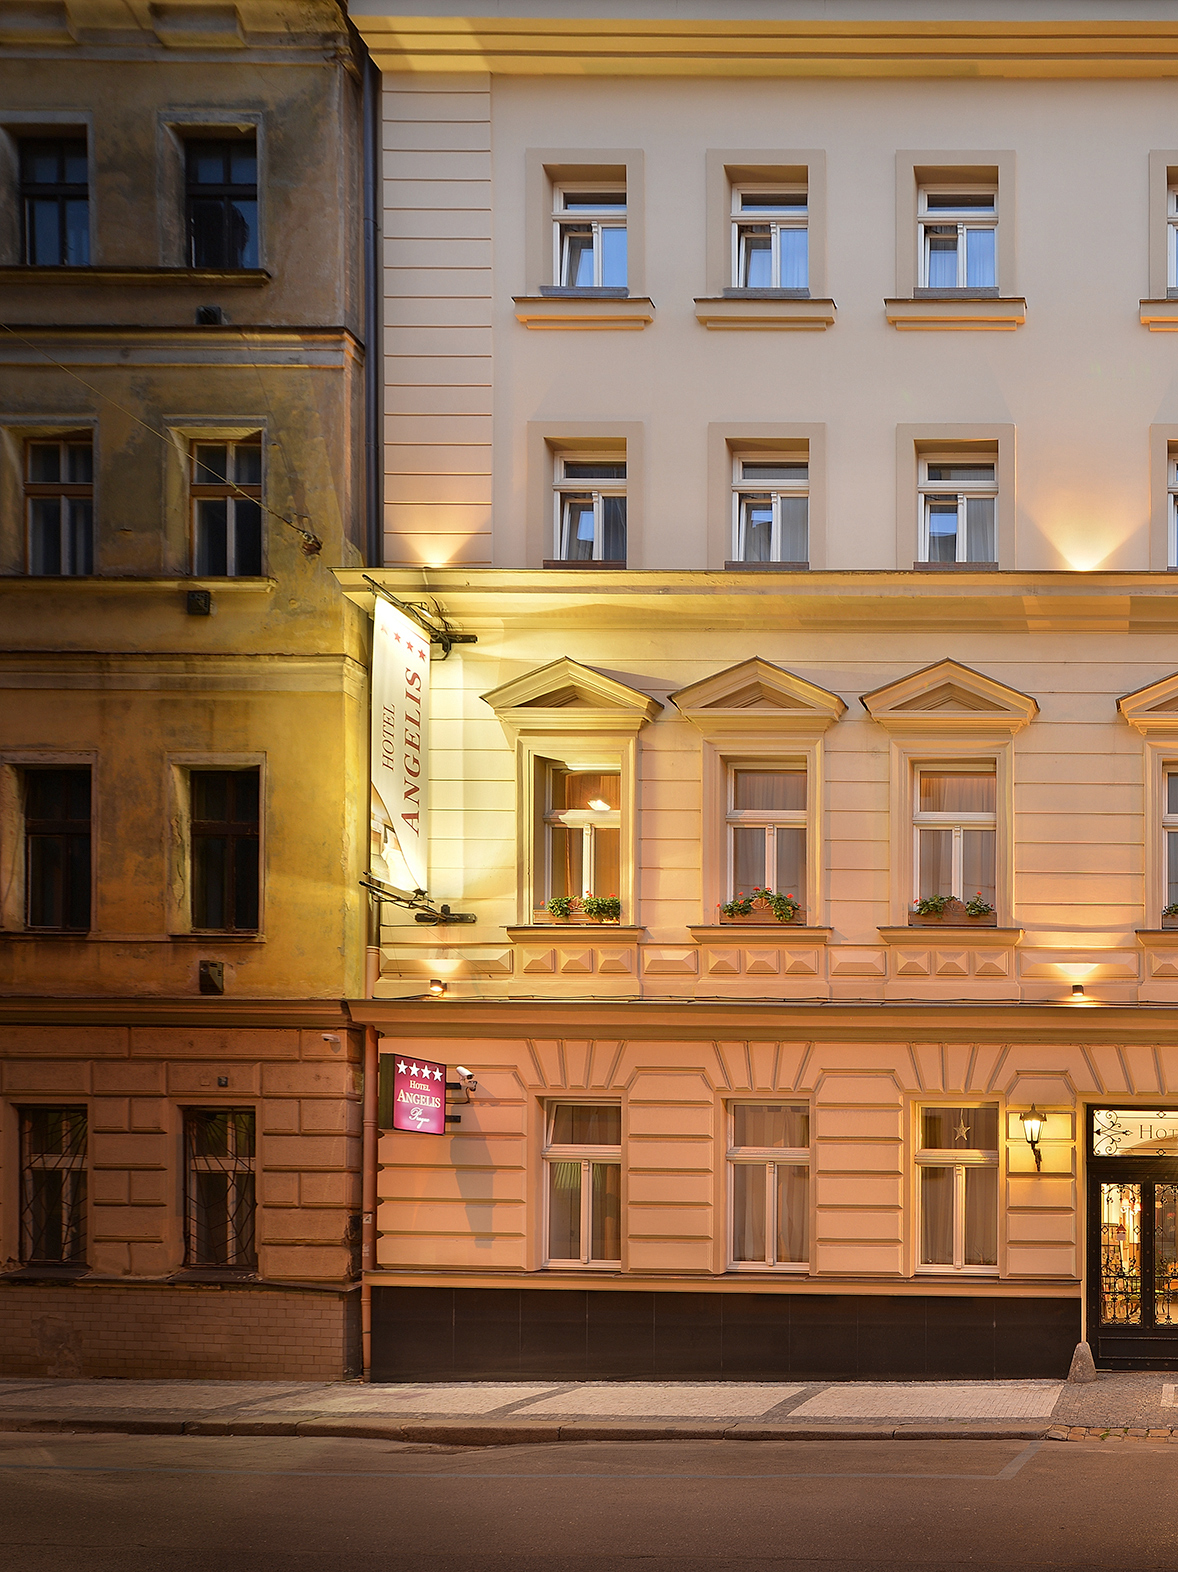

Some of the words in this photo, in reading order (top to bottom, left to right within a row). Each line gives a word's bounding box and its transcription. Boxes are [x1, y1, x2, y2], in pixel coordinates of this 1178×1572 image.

[382, 703, 396, 771] HOTEL
[400, 667, 421, 836] ANGELIS
[397, 1089, 441, 1108] ANGELIS
[409, 1080, 431, 1091] HOTEL
